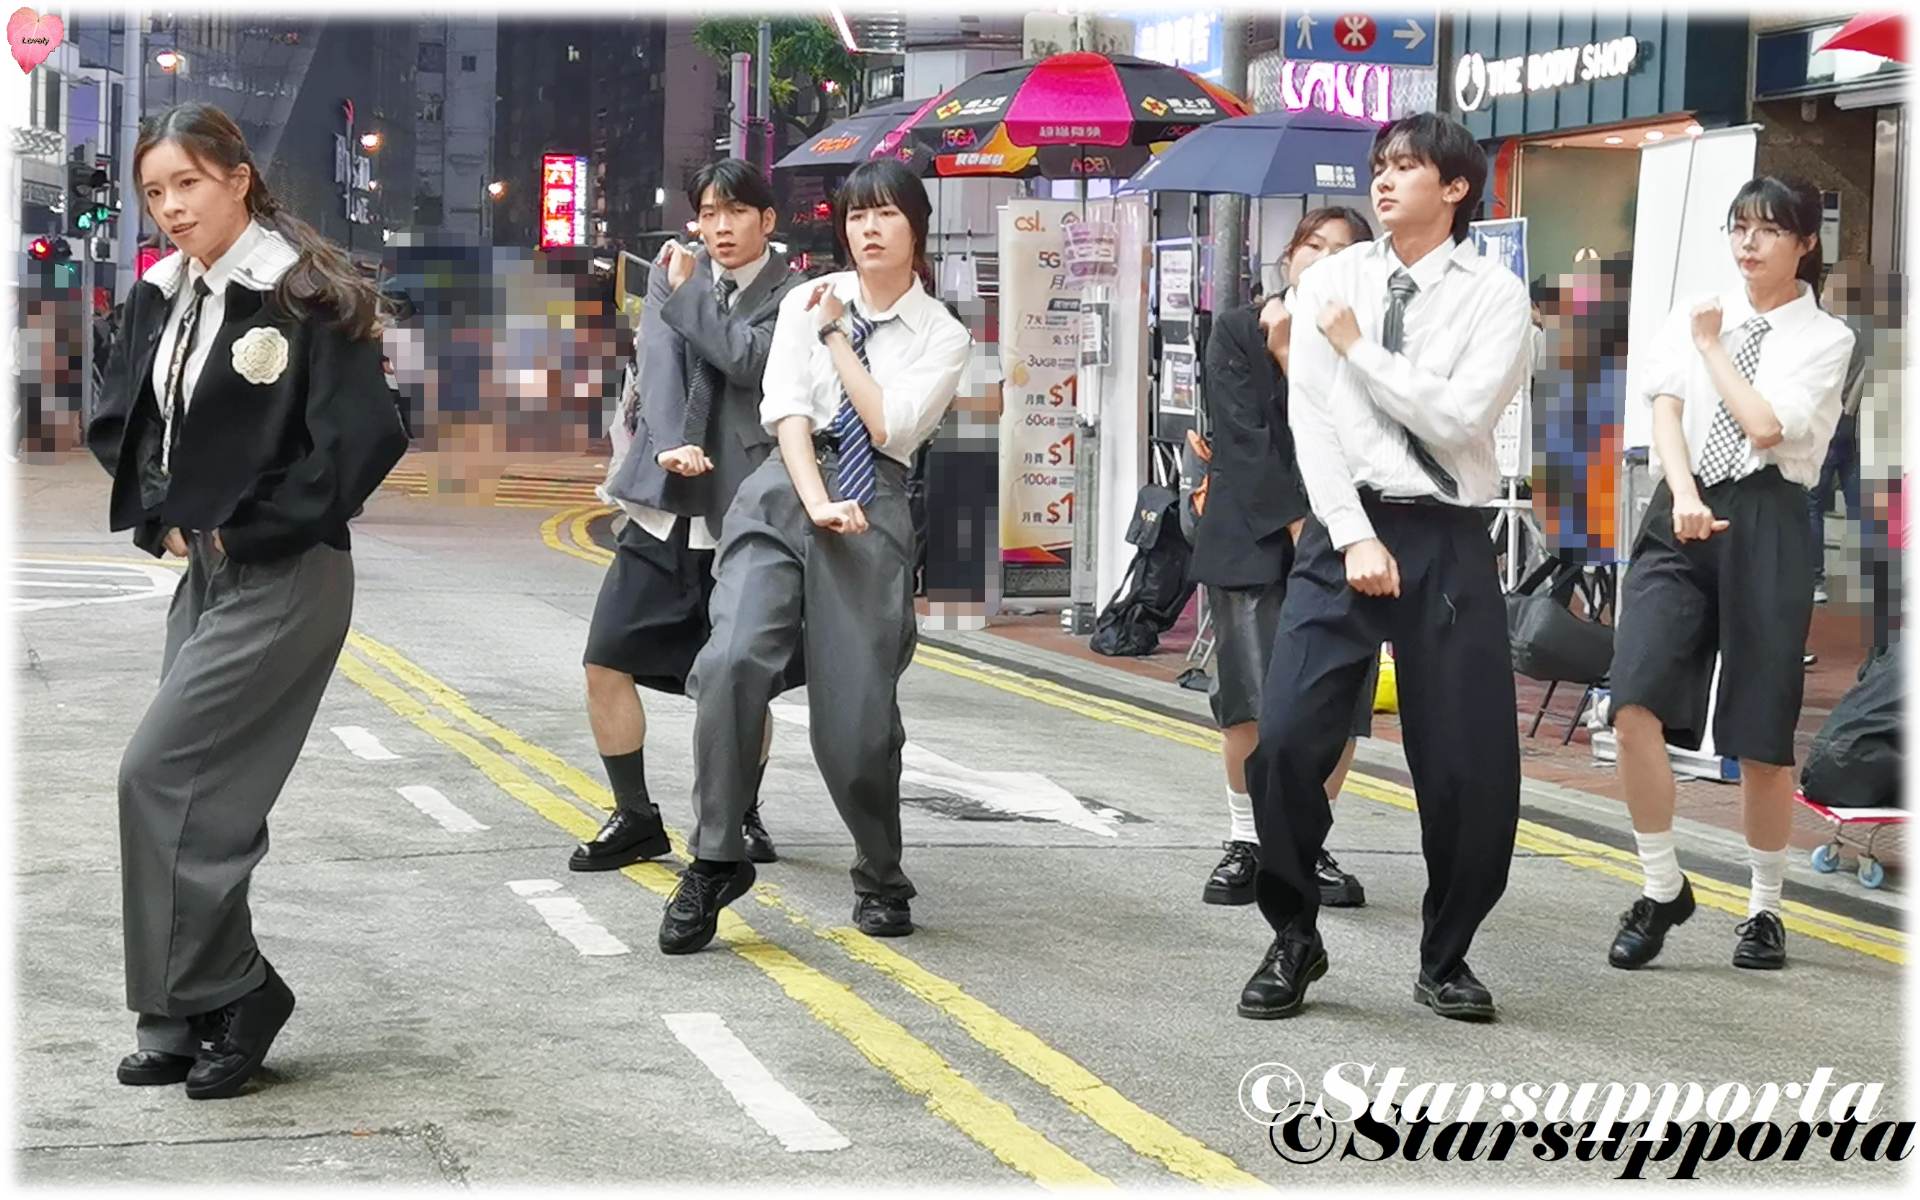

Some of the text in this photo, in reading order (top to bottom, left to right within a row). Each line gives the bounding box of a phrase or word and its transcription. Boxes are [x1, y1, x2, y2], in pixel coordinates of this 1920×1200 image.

[1486, 35, 1638, 96] THE BODY SHOP
[1014, 210, 1046, 232] csl.
[1039, 251, 1061, 268] 5G
[1025, 413, 1056, 426] 60GB
[1022, 472, 1057, 486] 100GB
